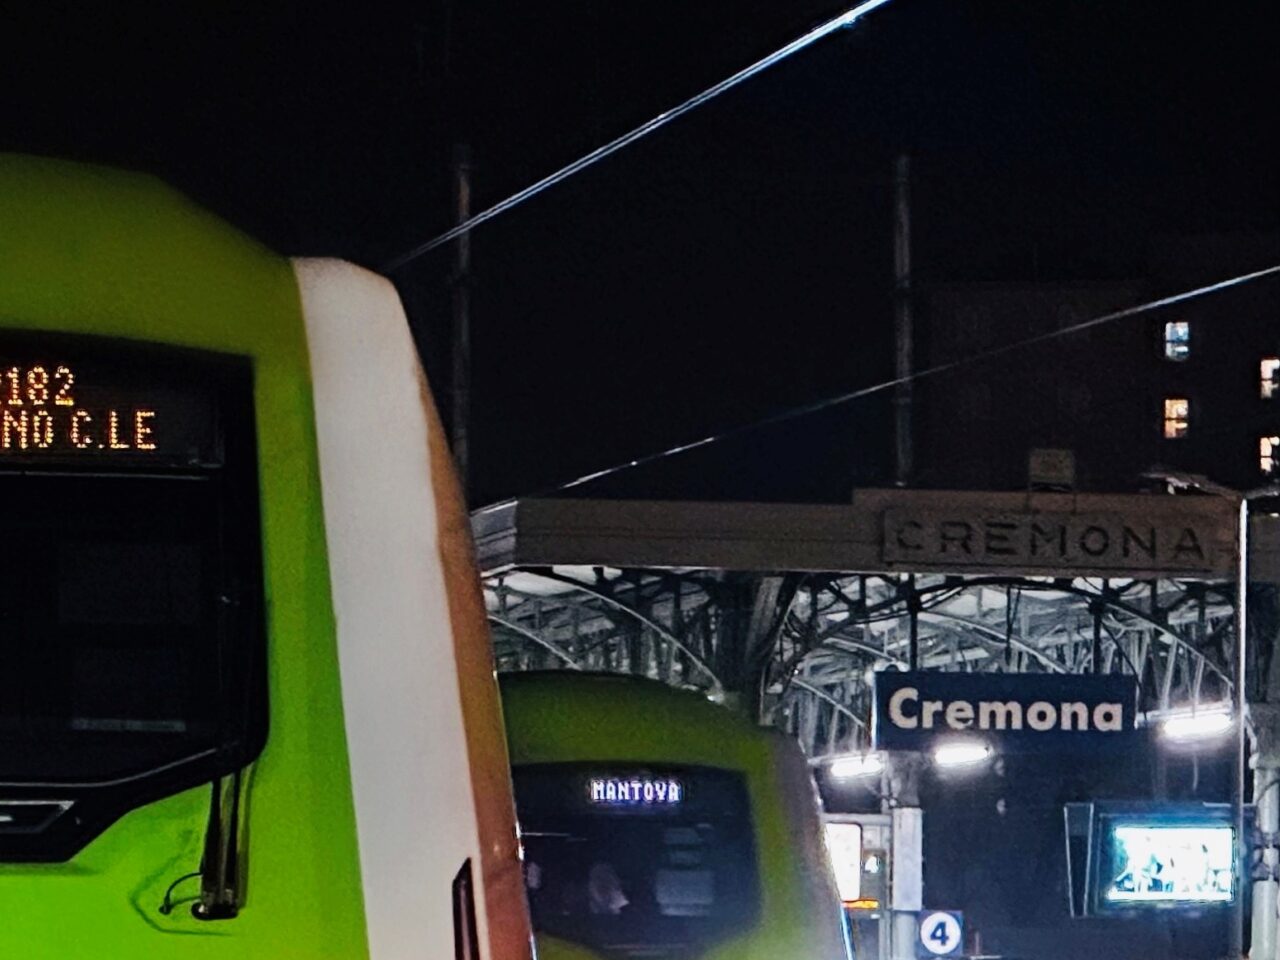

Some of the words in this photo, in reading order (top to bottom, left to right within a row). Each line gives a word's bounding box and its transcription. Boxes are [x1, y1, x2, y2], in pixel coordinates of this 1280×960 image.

[71, 409, 157, 450] C.LE
[894, 520, 1205, 561] CREMONA
[888, 686, 1124, 732] Cremona
[592, 780, 681, 802] MANTOVA
[929, 920, 950, 947] 4
